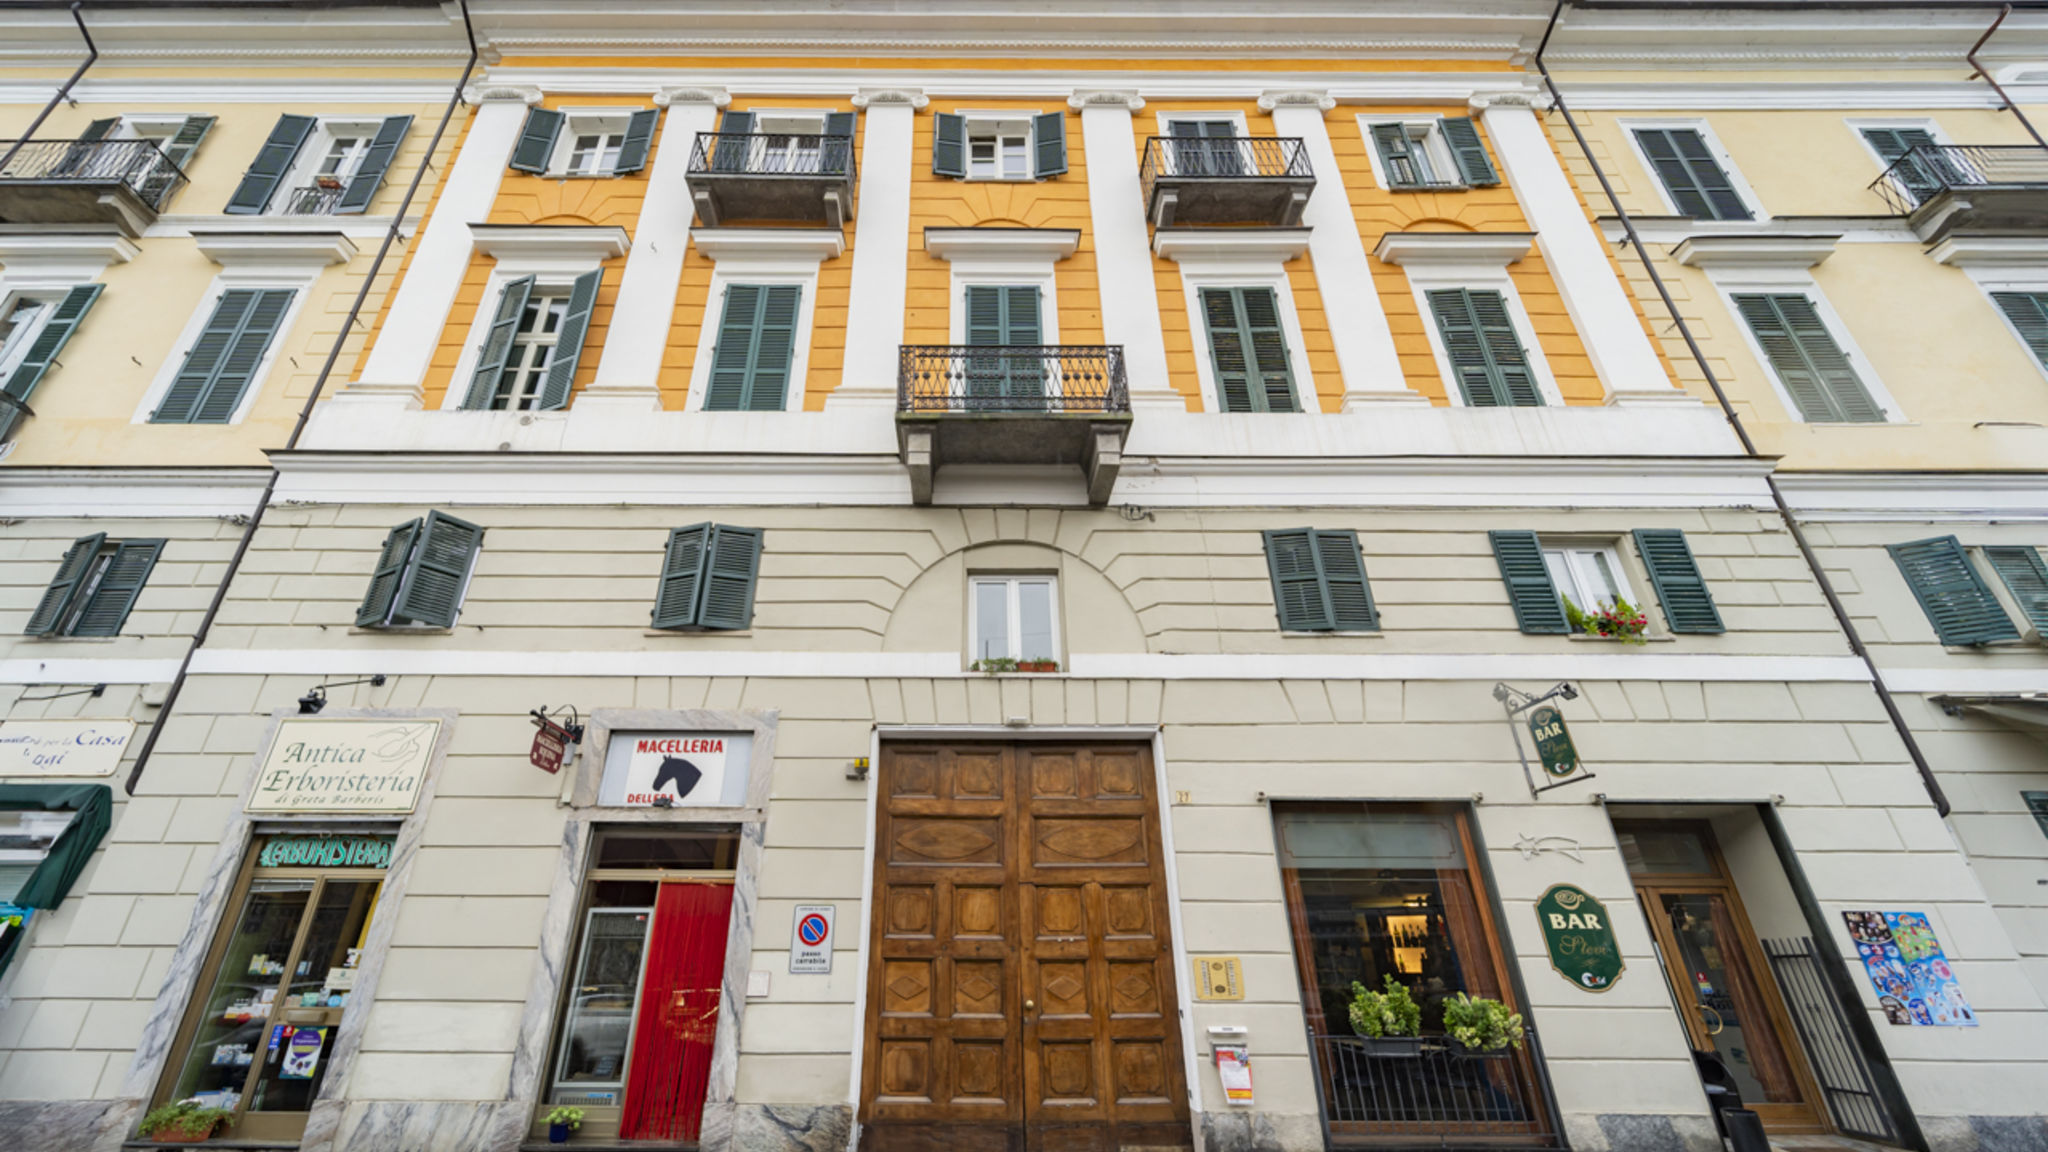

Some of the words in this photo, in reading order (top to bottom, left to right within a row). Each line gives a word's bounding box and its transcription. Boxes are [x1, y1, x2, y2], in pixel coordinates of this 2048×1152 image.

[75, 730, 126, 746] Casa
[1535, 722, 1563, 742] BAR
[283, 742, 366, 763] Antica
[636, 739, 723, 753] MACELLERIA
[262, 764, 415, 792] Erboristeria
[1548, 913, 1603, 930] BAR
